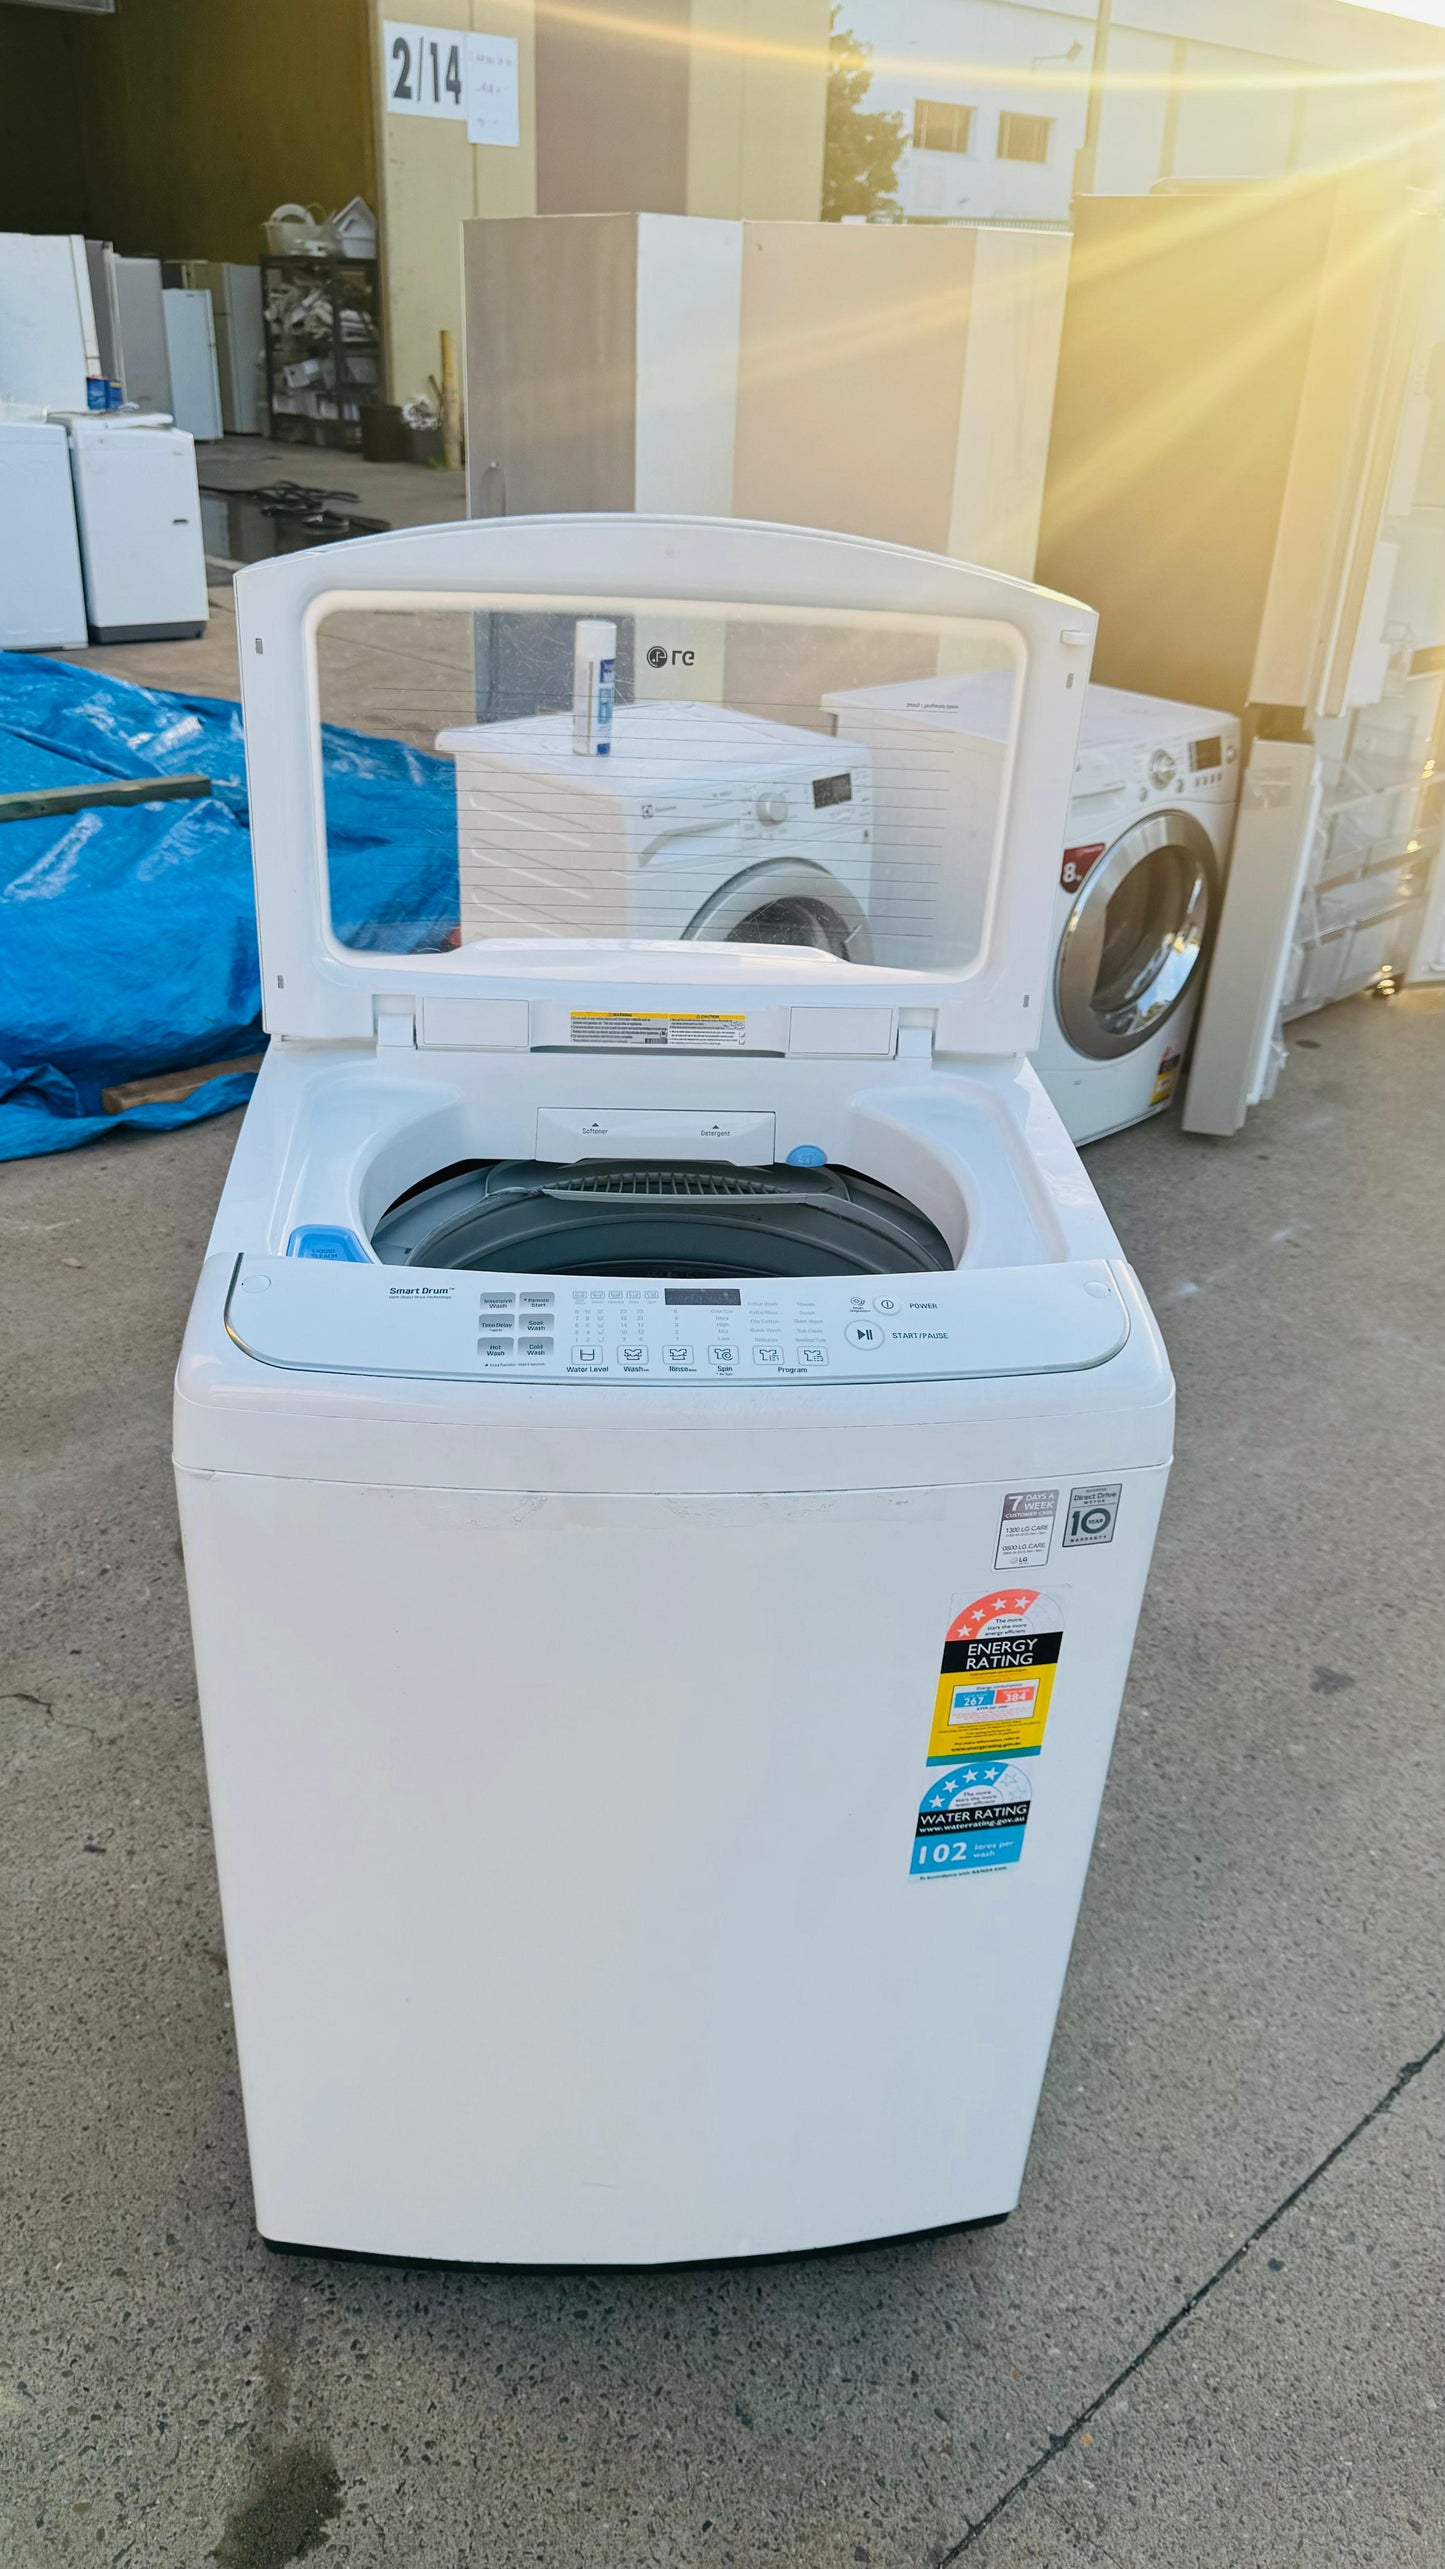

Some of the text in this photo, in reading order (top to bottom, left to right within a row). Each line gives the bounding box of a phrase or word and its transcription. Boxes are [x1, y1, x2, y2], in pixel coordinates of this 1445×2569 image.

[392, 36, 462, 105] 2/14
[582, 1127, 608, 1135] Softener
[389, 1287, 420, 1295] Smart
[777, 1366, 808, 1374] Program
[1008, 1495, 1024, 1512] 7
[1025, 1493, 1046, 1501] DAYS
[1024, 1501, 1054, 1510] WEEK
[1005, 1511, 1037, 1519] CUSTOMER
[1072, 1507, 1111, 1536] 10
[967, 1638, 1038, 1656] ENERGY
[966, 1653, 1034, 1670] RATING
[963, 1696, 985, 1706] 267
[1004, 1692, 1026, 1703] 384
[951, 1741, 1022, 1752] www.energyrating.gov.au
[920, 1804, 1028, 1825] WATER RATING
[919, 1816, 1026, 1833] www.waterrating.gov.au
[918, 1840, 1015, 1865] 102 litres per
[972, 1850, 996, 1858] wash
